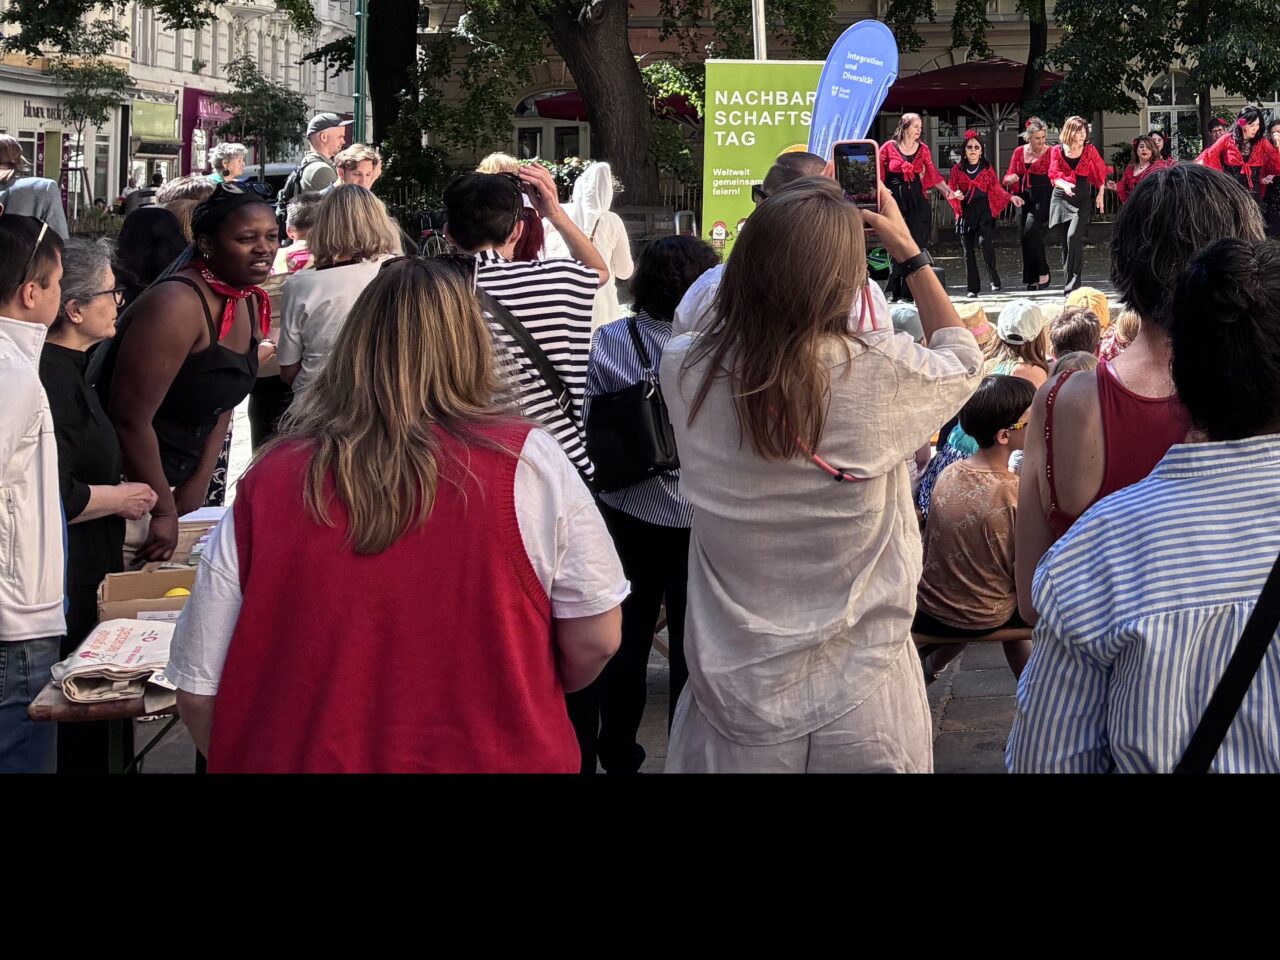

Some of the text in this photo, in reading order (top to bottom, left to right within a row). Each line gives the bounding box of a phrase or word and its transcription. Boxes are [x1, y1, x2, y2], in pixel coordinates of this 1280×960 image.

[847, 51, 884, 67] Integration
[844, 63, 858, 71] und
[715, 90, 816, 106] NACHBAR
[714, 110, 812, 126] SCHAFTS
[713, 131, 756, 146] TAG
[712, 168, 750, 176] Weltweit
[712, 178, 764, 188] gemeinsam
[712, 187, 741, 196] feiern!
